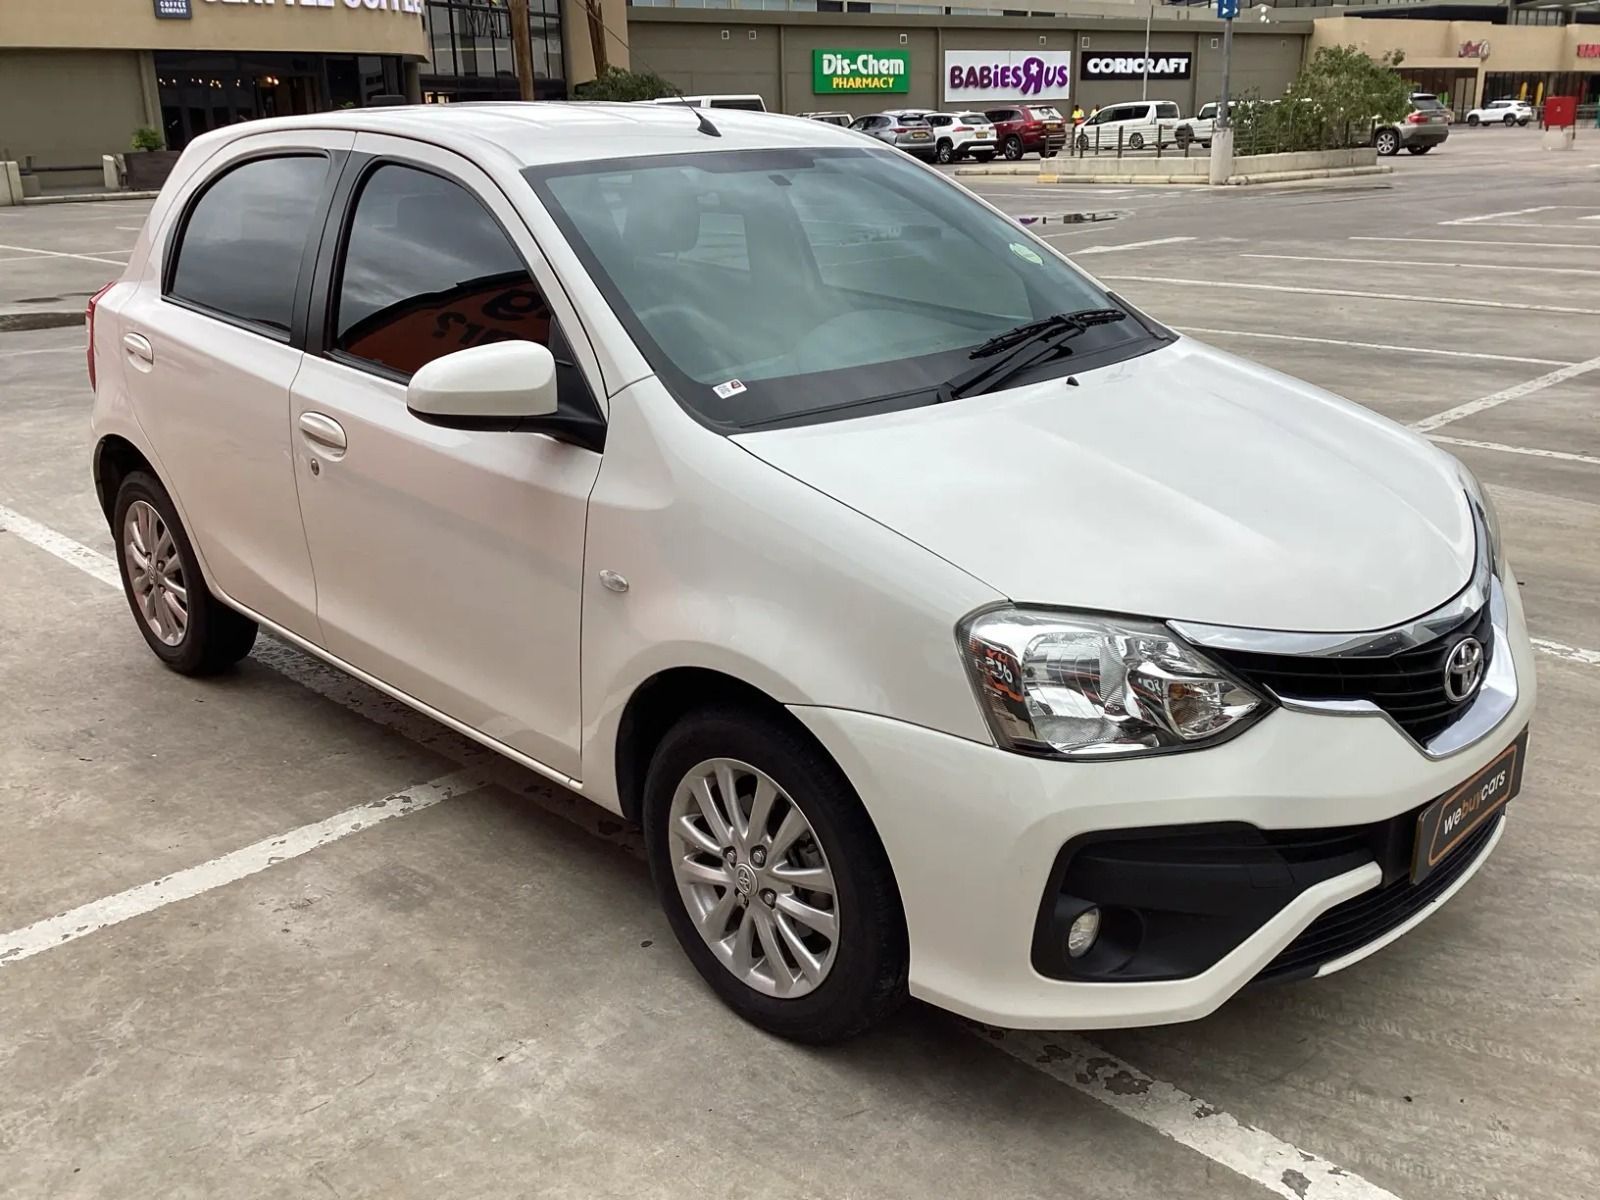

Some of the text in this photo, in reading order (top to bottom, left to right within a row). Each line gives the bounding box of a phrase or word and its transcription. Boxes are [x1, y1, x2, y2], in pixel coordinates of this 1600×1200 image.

[822, 54, 905, 75] Dis-Chem
[1086, 57, 1189, 74] CORICRAFT
[832, 77, 895, 89] PHARMACY
[1044, 65, 1068, 88] US
